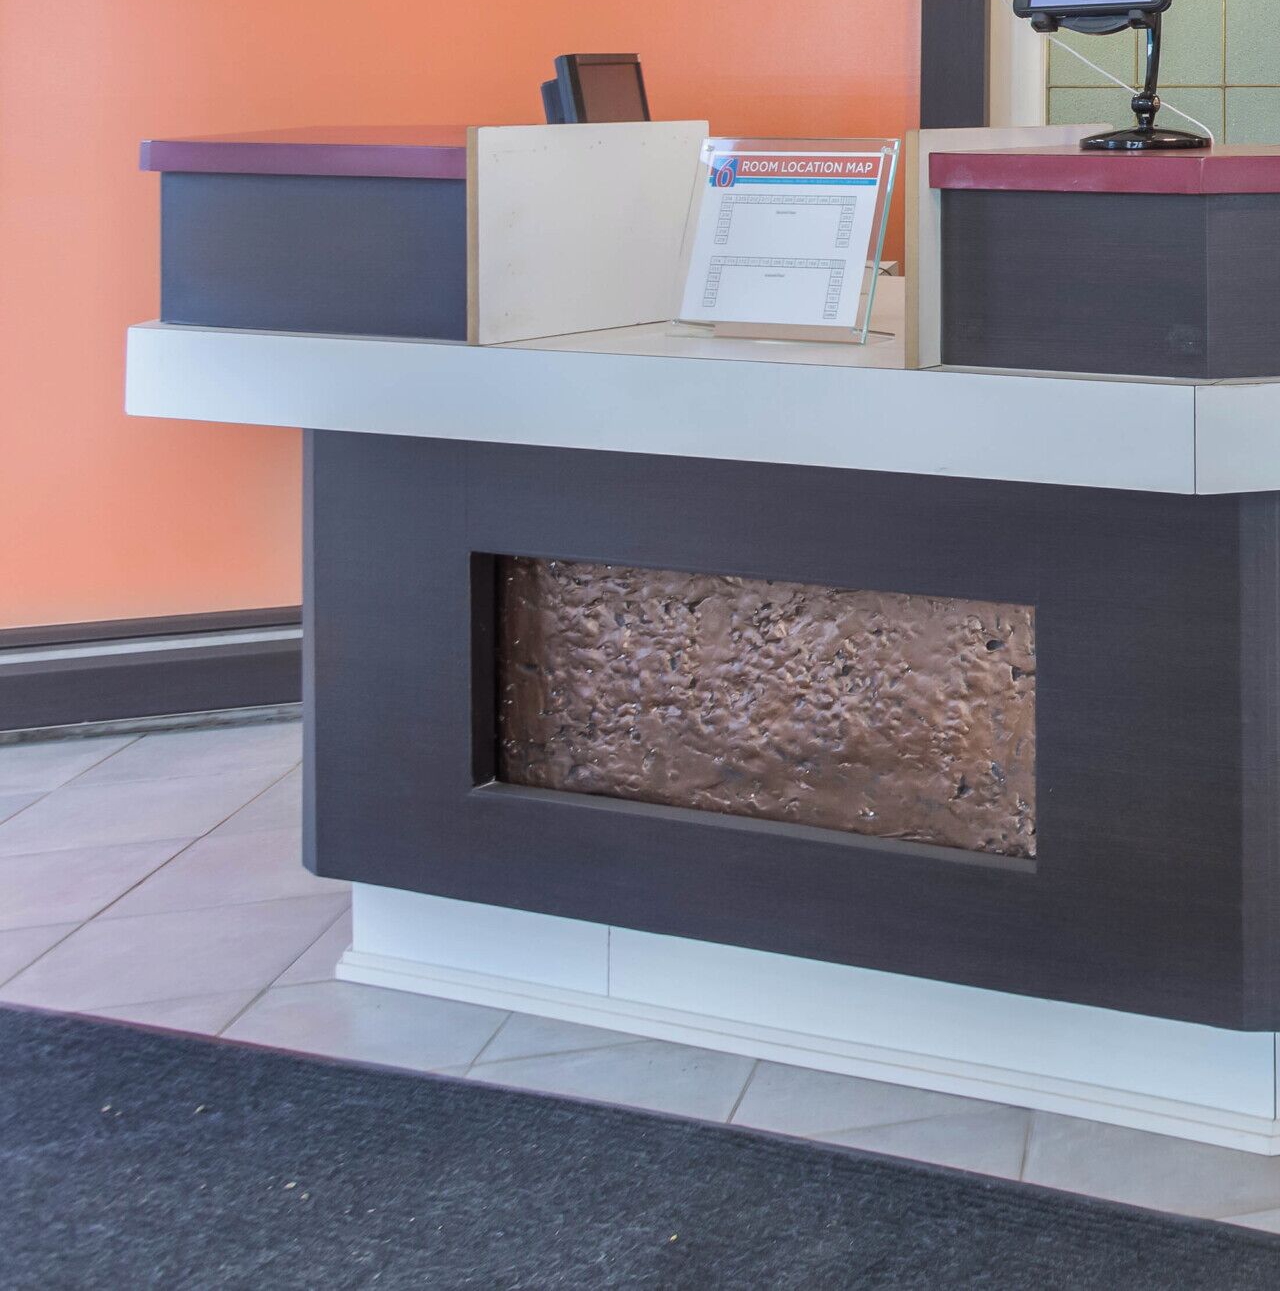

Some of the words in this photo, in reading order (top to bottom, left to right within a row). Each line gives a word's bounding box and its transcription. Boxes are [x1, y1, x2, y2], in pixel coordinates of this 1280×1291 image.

[715, 158, 735, 187] 6
[741, 161, 779, 173] ROOM
[781, 161, 843, 174] LOCATION
[845, 161, 873, 174] MAP
